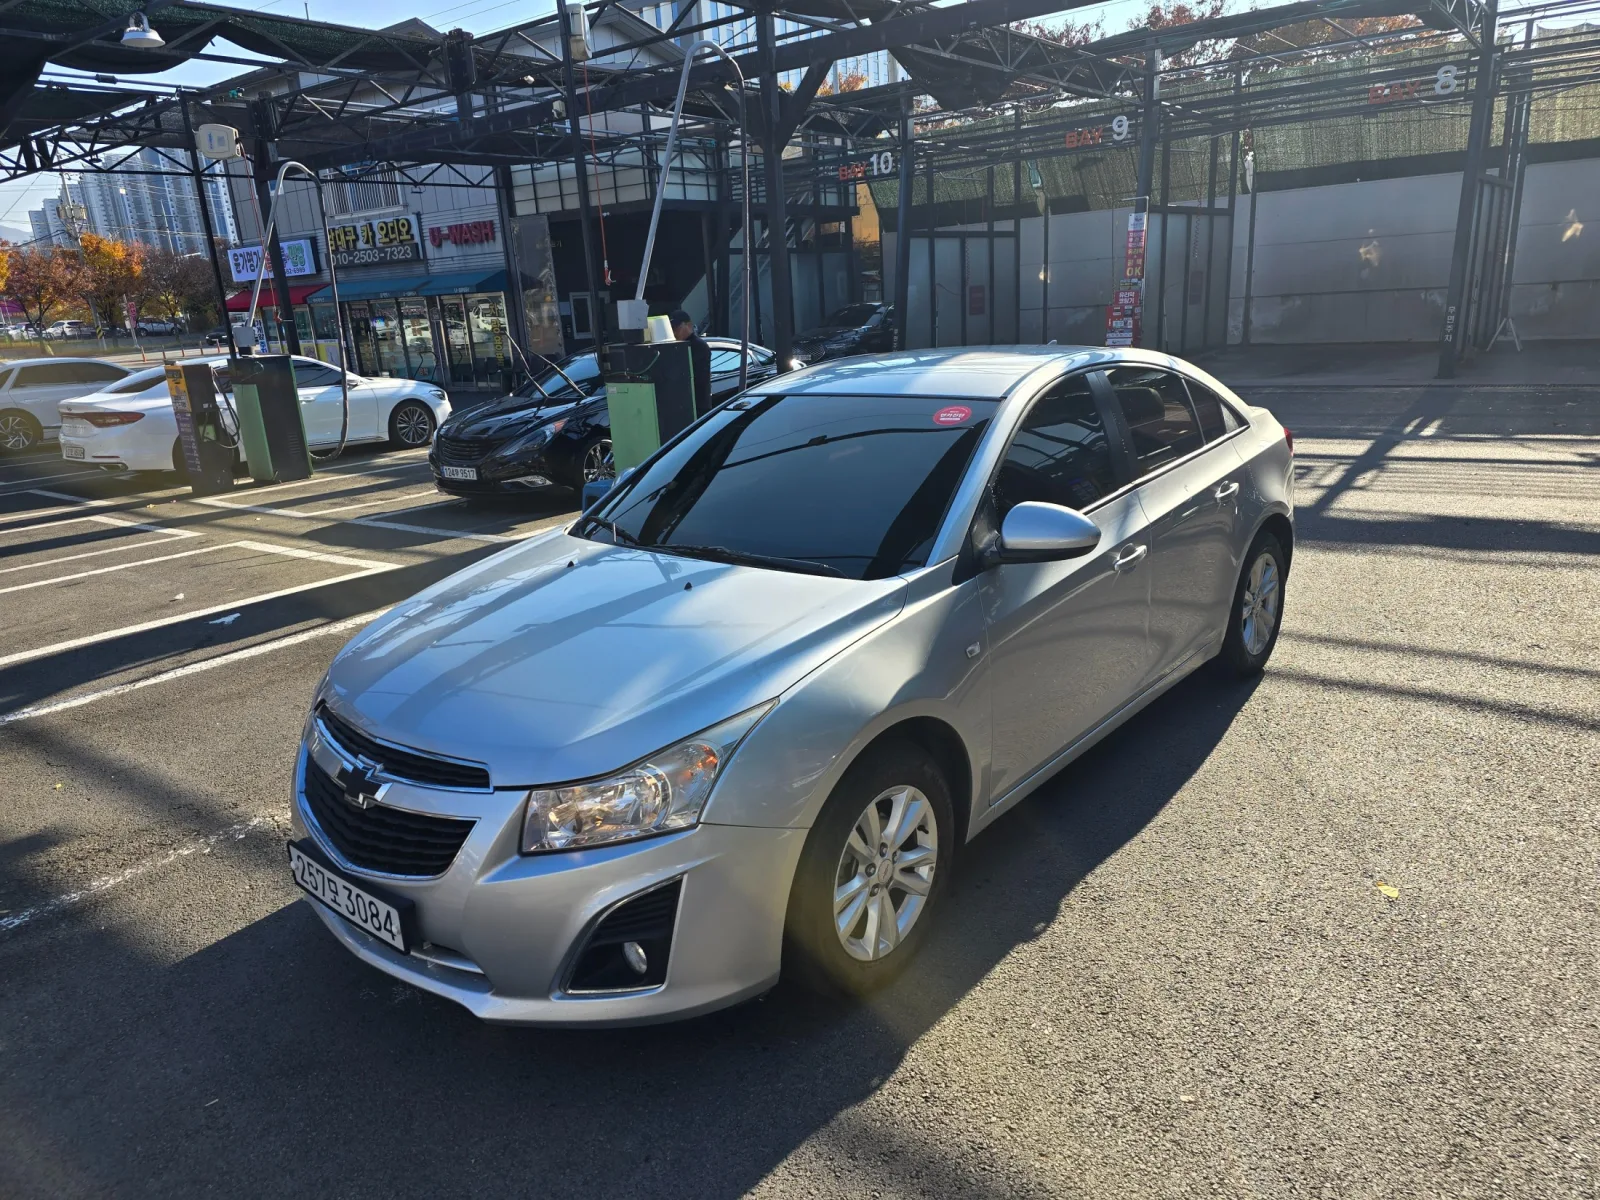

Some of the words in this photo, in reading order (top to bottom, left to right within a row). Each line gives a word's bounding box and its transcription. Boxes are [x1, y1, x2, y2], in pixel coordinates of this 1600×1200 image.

[1368, 80, 1420, 104] BAY
[1434, 65, 1457, 95] 8
[1065, 128, 1103, 149] BAY
[1112, 115, 1129, 141] 9
[838, 161, 867, 180] BAY
[869, 152, 893, 176] 10
[361, 222, 373, 247] 카
[377, 218, 411, 244] 오디오
[429, 220, 494, 247] U-WASH
[331, 246, 413, 267] 010-2503-7323
[1126, 266, 1142, 277] OK
[296, 854, 342, 908] 257모
[342, 884, 397, 942] 3084
